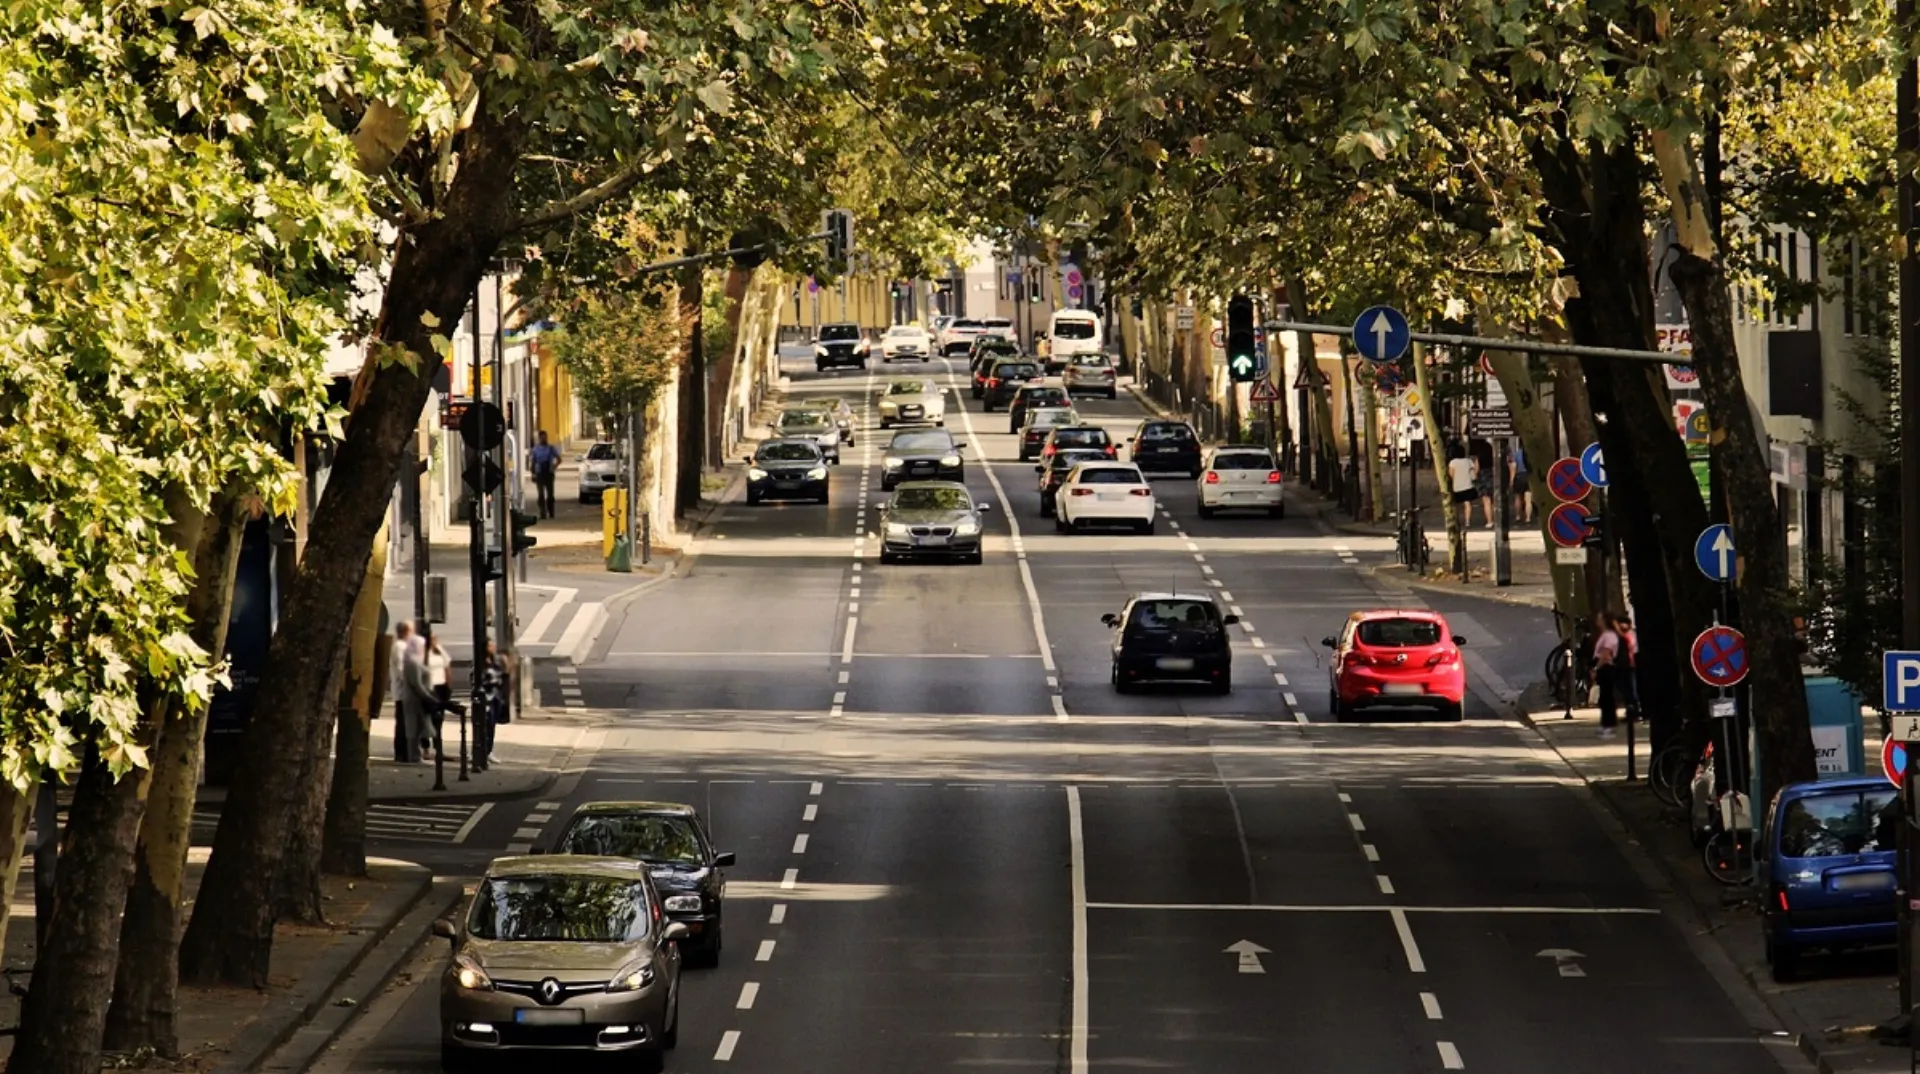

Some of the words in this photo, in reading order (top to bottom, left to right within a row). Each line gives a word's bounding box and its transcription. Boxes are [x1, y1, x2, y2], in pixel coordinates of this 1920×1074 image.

[1656, 329, 1692, 345] PFA
[1896, 659, 1920, 704] P
[1815, 748, 1837, 758] ENT
